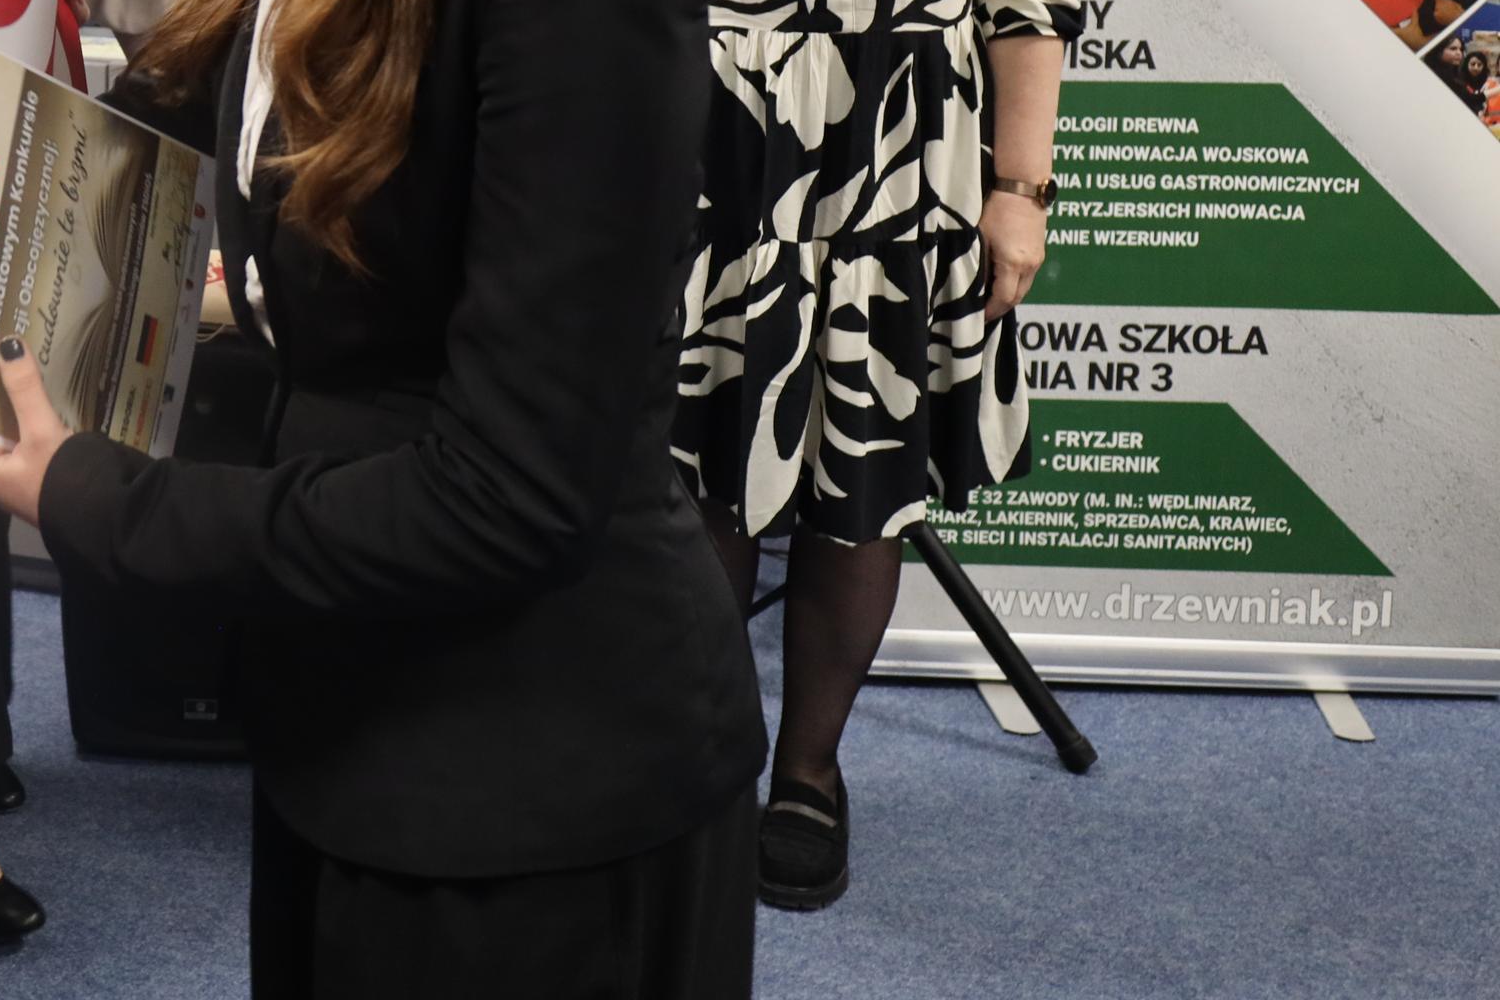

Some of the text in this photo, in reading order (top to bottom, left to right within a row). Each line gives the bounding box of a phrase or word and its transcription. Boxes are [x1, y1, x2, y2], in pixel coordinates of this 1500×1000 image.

[1064, 36, 1157, 70] ISKA
[1122, 117, 1200, 134] DREWNA
[10, 89, 39, 202] Konkursie
[1052, 144, 1310, 164] TYK INNOWACJA WOJSKOWA
[1051, 173, 1360, 194] NIA I USŁUG GASTRONOMICZNYCH
[1058, 201, 1191, 219] FRYZJERSKICH
[1195, 203, 1306, 221] INNOWACJA
[1094, 230, 1200, 247] WIZERUNKU
[37, 239, 71, 366] cudownie
[57, 207, 75, 235] to
[14, 307, 30, 335] zji
[1119, 323, 1269, 356] SZKOŁA
[1087, 361, 1140, 392] NR
[1150, 363, 1174, 392] 3
[1054, 430, 1144, 450] FRYZJER
[1052, 454, 1161, 474] CUKIERNIK
[981, 490, 1002, 505] 32
[1006, 490, 1080, 507] ZAWODY
[1083, 492, 1110, 510] (M.
[1114, 493, 1143, 509] IN.:
[1147, 494, 1256, 514] WĘDLINIARZ,
[986, 511, 1079, 530] LAKIERNIK,
[1083, 513, 1205, 532] SPRZEDAWCA,
[1209, 516, 1292, 536] KRAWIEC,
[962, 530, 1005, 545] SIECI
[1009, 531, 1015, 546] I
[1019, 531, 1119, 548] INSTALACJI
[1123, 534, 1253, 555] SANITARNYCH)
[982, 582, 1393, 636] www.drzewniak.pl
